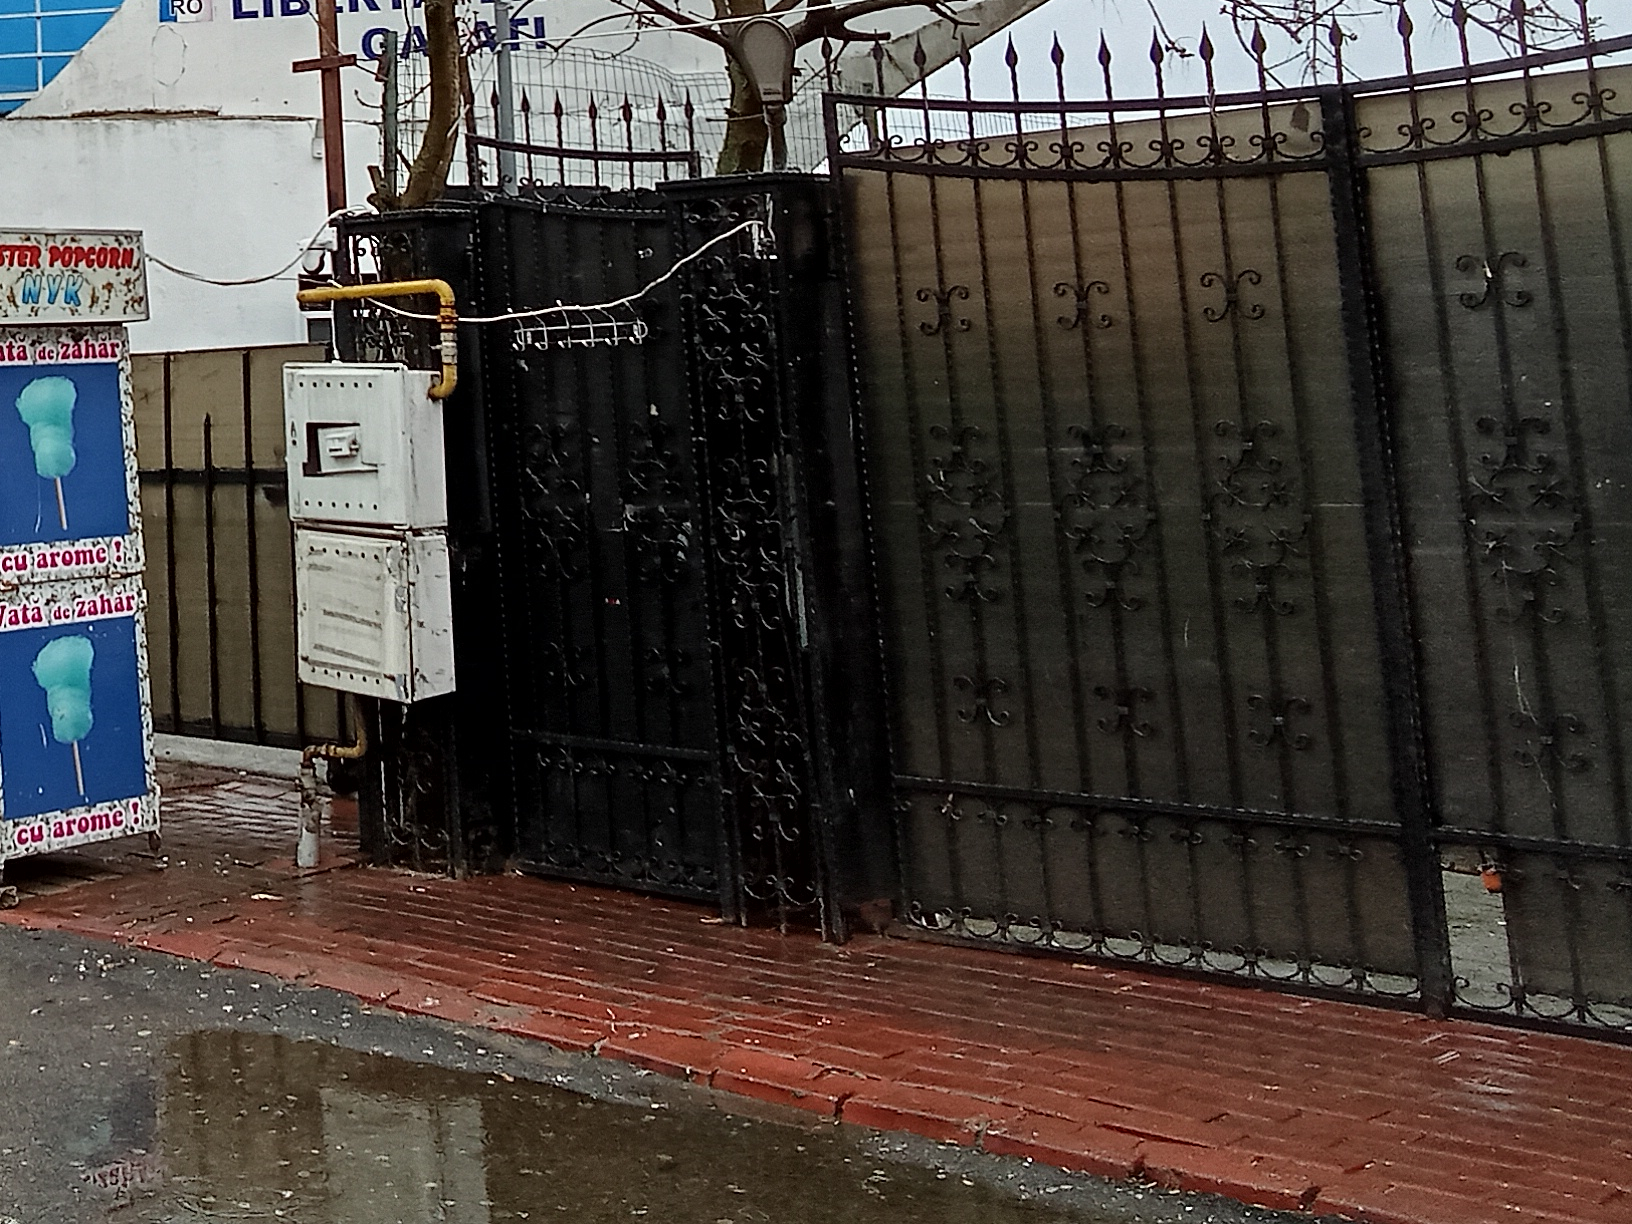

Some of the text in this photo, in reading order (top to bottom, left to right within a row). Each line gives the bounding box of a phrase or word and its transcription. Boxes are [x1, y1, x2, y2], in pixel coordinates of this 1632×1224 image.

[47, 245, 135, 270] POPCORN
[21, 273, 85, 307] NYK
[37, 346, 59, 361] de
[60, 335, 121, 360] zahăr
[1, 554, 28, 573] cu
[36, 546, 108, 569] arome
[53, 606, 71, 620] de
[75, 591, 136, 618] zahăr
[16, 824, 45, 846] cu
[52, 810, 125, 839] arome
